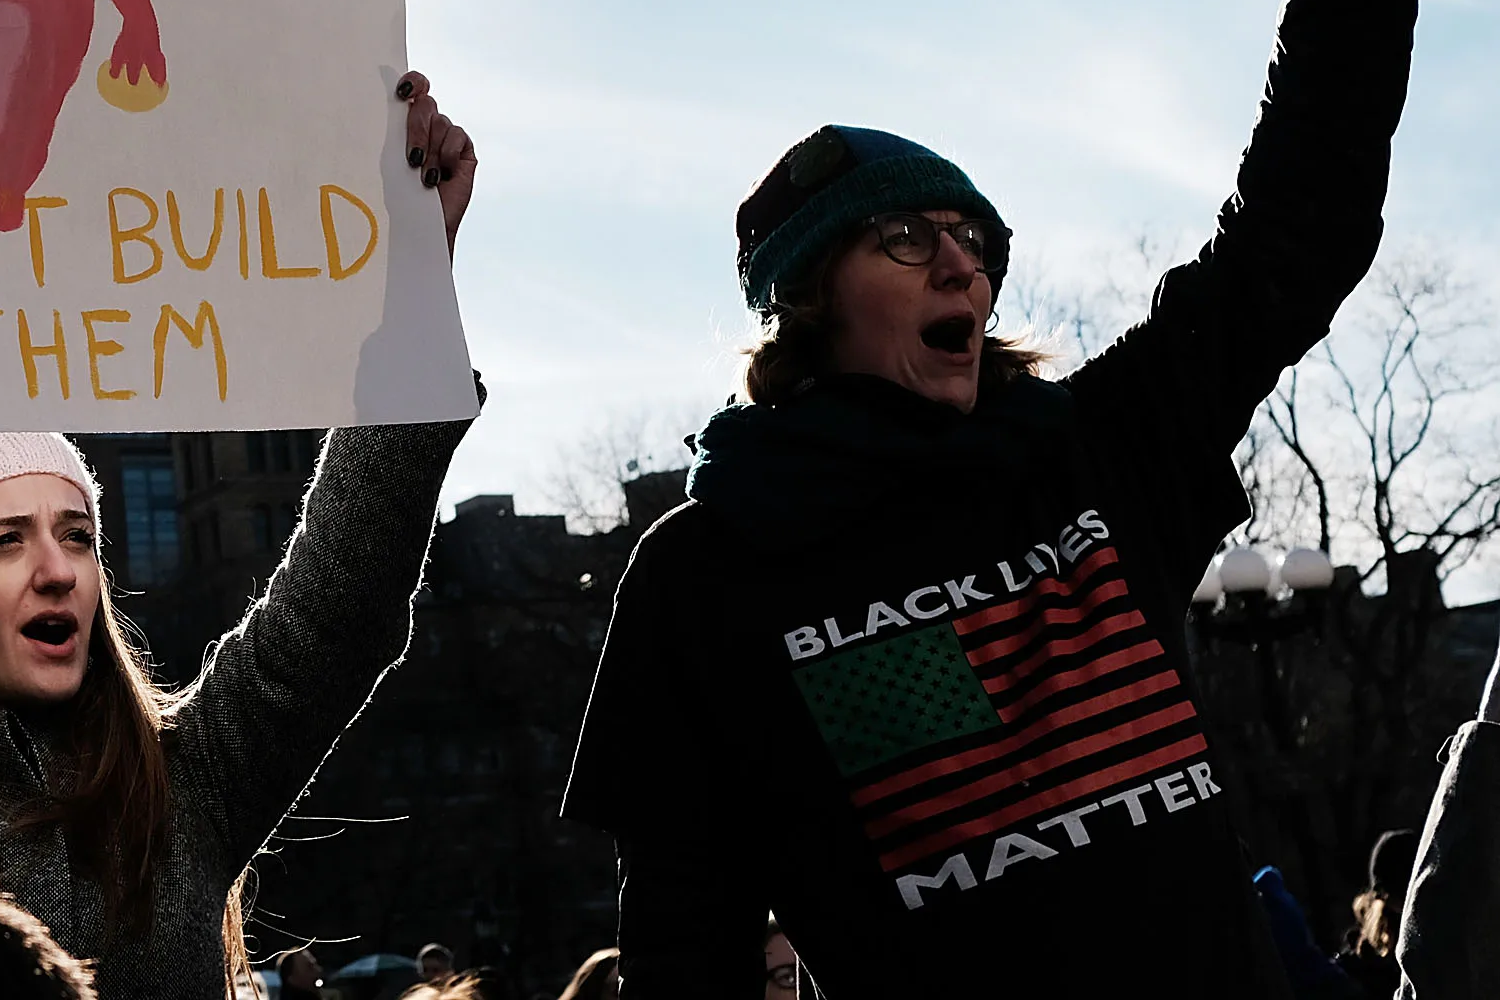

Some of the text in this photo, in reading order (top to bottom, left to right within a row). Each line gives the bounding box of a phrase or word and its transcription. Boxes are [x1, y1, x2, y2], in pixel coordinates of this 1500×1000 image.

[108, 184, 379, 284] BUILD
[784, 509, 1110, 662] BLACK LIVES
[895, 761, 1222, 910] MATTER
